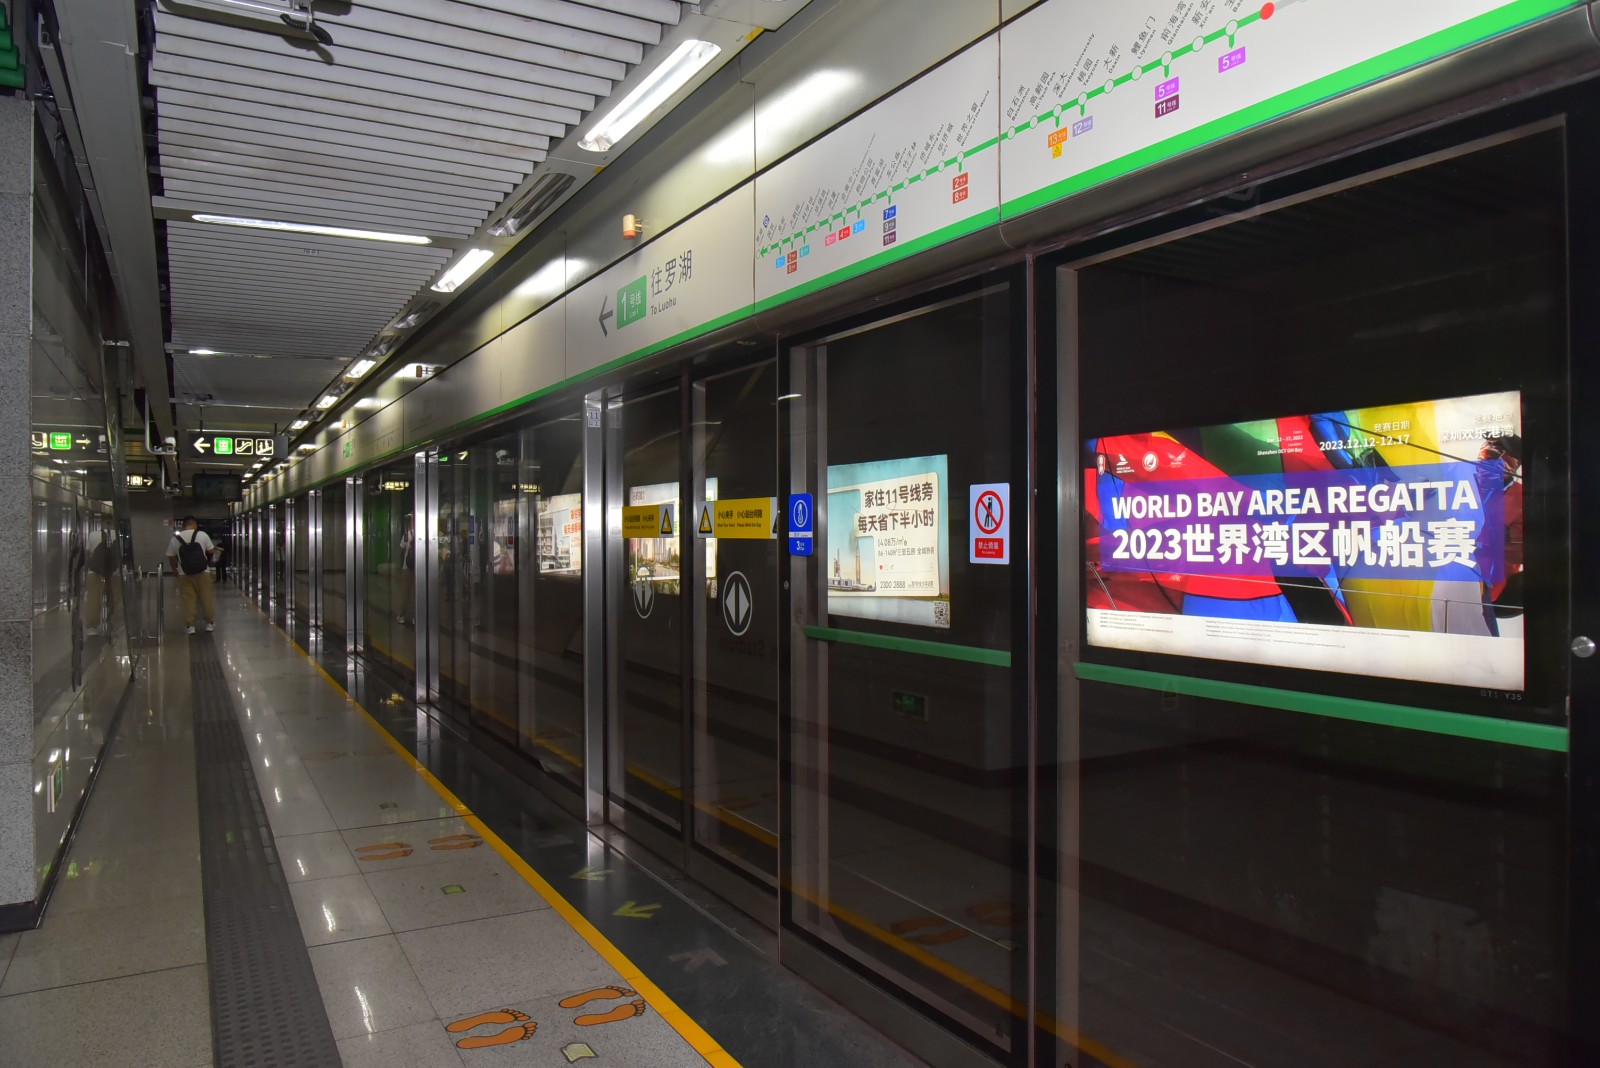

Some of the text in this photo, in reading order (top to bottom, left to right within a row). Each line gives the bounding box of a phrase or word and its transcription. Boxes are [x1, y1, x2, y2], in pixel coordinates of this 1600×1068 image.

[1168, 2, 1194, 45] Qianhaiwan
[1075, 33, 1095, 67] University
[1103, 43, 1119, 70] 大新
[1137, 29, 1156, 60] Liyumen
[1108, 54, 1121, 74] Daxin
[1007, 85, 1025, 118] 白石洲
[650, 249, 692, 298] 往罗湖
[651, 298, 677, 316] To Luohu
[1373, 420, 1410, 432] 竞赛日期
[1440, 425, 1514, 442] 深圳欢乐港湾
[1319, 434, 1410, 451] 2023.12.12-12.17
[864, 482, 933, 508] 家住11号线旁
[1112, 480, 1479, 520] WORLD BAY AREA REGATTA
[858, 508, 935, 533] 每天省下半小时
[1112, 518, 1478, 569] 2023世界湾区帆船赛
[1504, 692, 1522, 700] Y35
